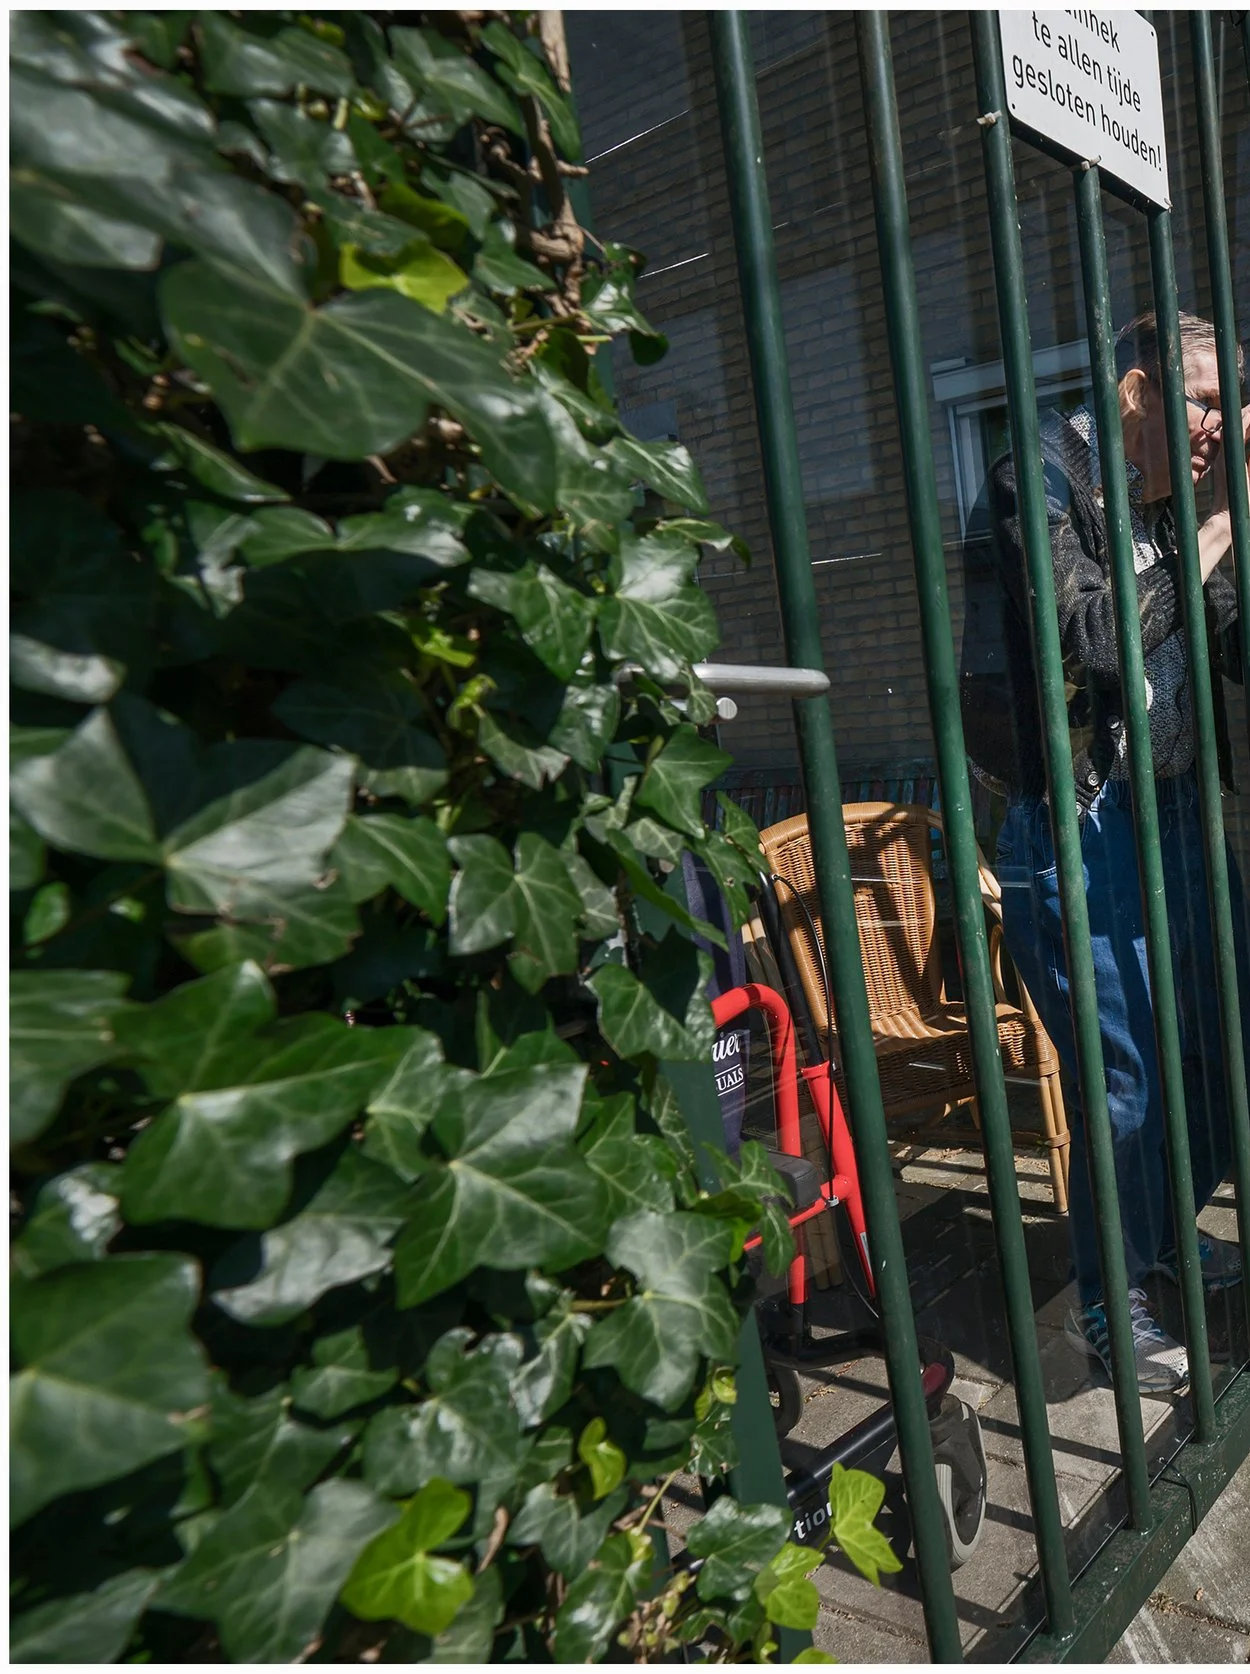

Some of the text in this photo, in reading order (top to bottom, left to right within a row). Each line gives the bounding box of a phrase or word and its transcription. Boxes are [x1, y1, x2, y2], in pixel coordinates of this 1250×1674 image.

[1032, 11, 1141, 112] te allen tijde
[1012, 54, 1162, 172] gesloten houden!
[715, 1067, 744, 1091] UALS
